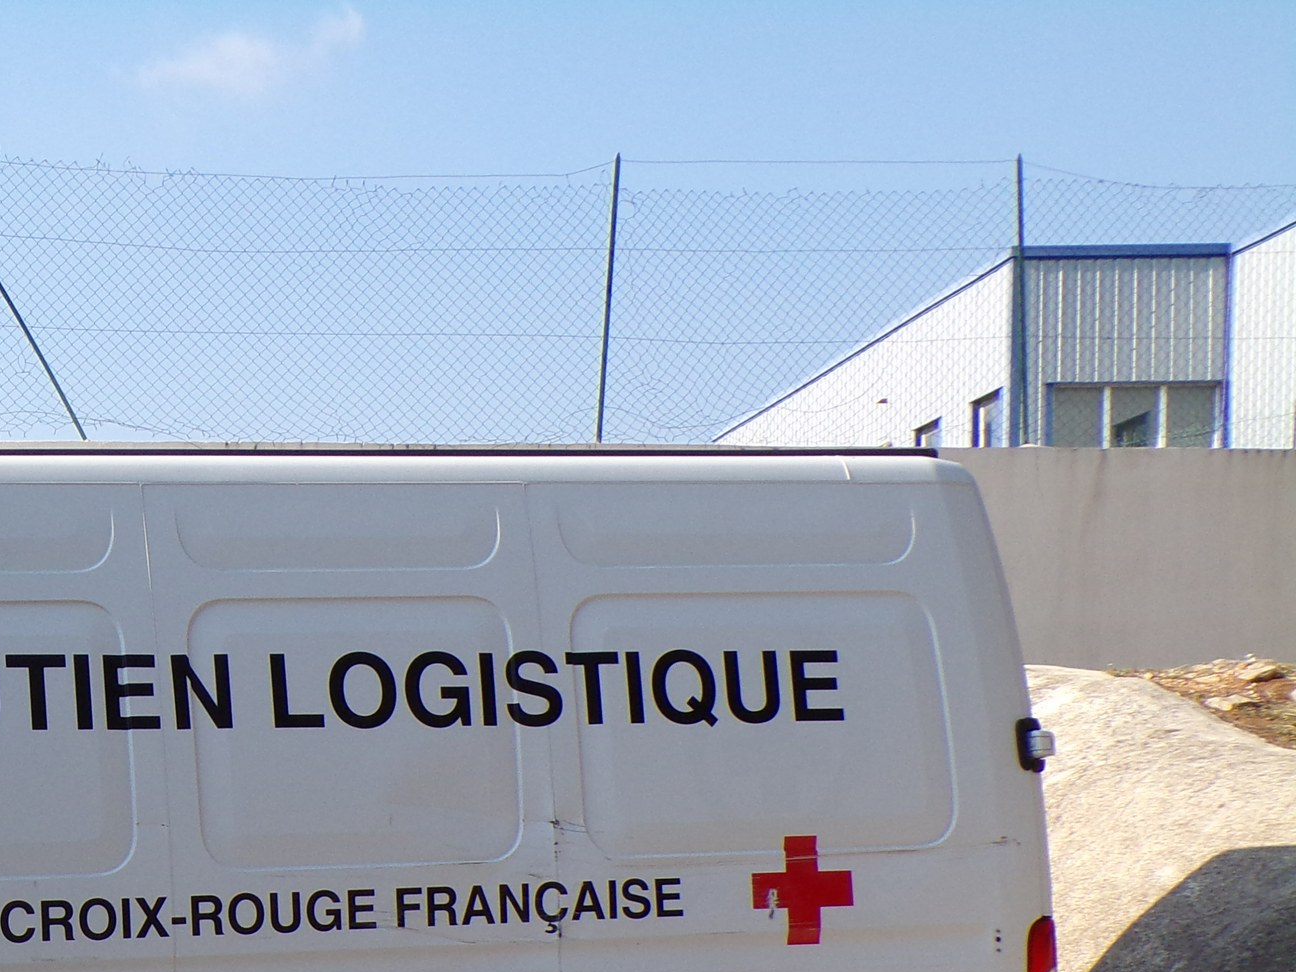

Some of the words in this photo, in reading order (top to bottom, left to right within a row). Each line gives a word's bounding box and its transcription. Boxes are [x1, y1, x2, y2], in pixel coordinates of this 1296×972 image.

[269, 649, 845, 730] LOGISTIQUE
[0, 888, 378, 944] CROIX-ROUGE
[395, 877, 684, 939] FRANÇAISE
